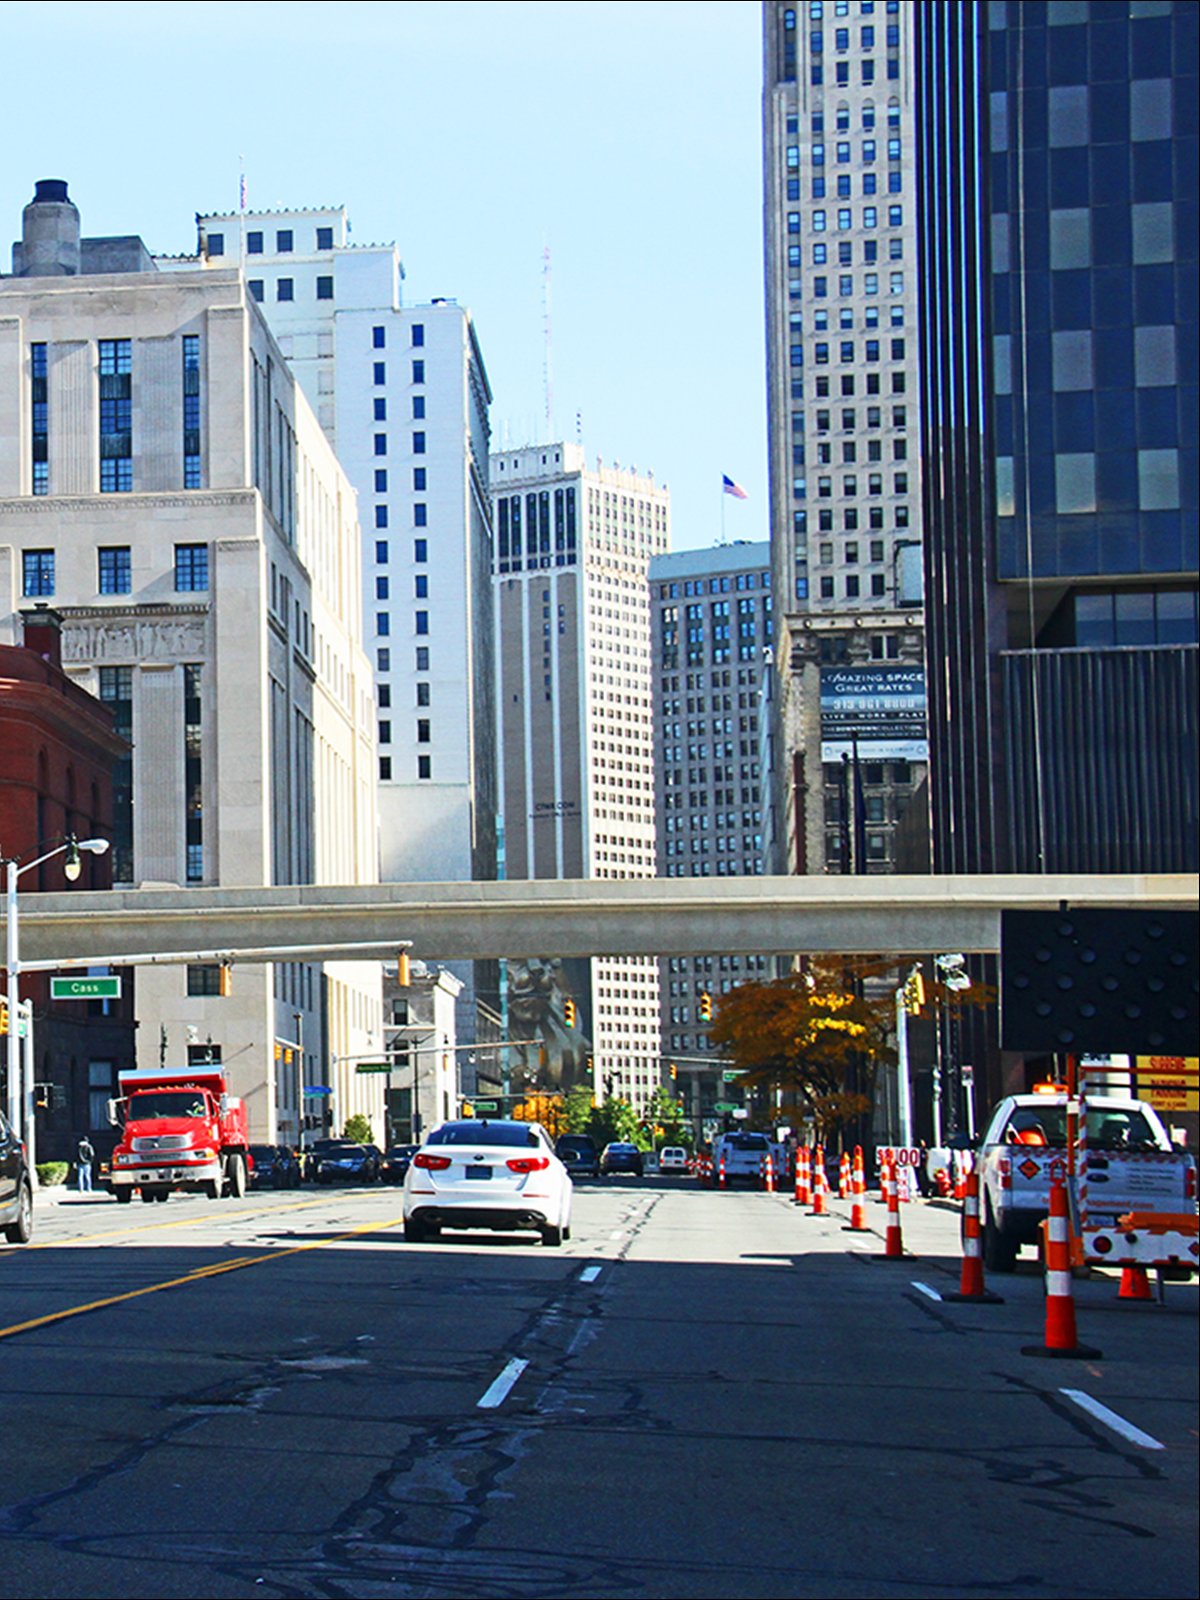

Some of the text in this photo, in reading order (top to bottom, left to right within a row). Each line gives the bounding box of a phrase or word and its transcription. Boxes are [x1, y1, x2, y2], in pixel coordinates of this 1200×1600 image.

[822, 673, 924, 682] AMAZING SPACE
[835, 684, 874, 692] GREAT
[833, 699, 855, 709] 313
[71, 983, 99, 993] Cass
